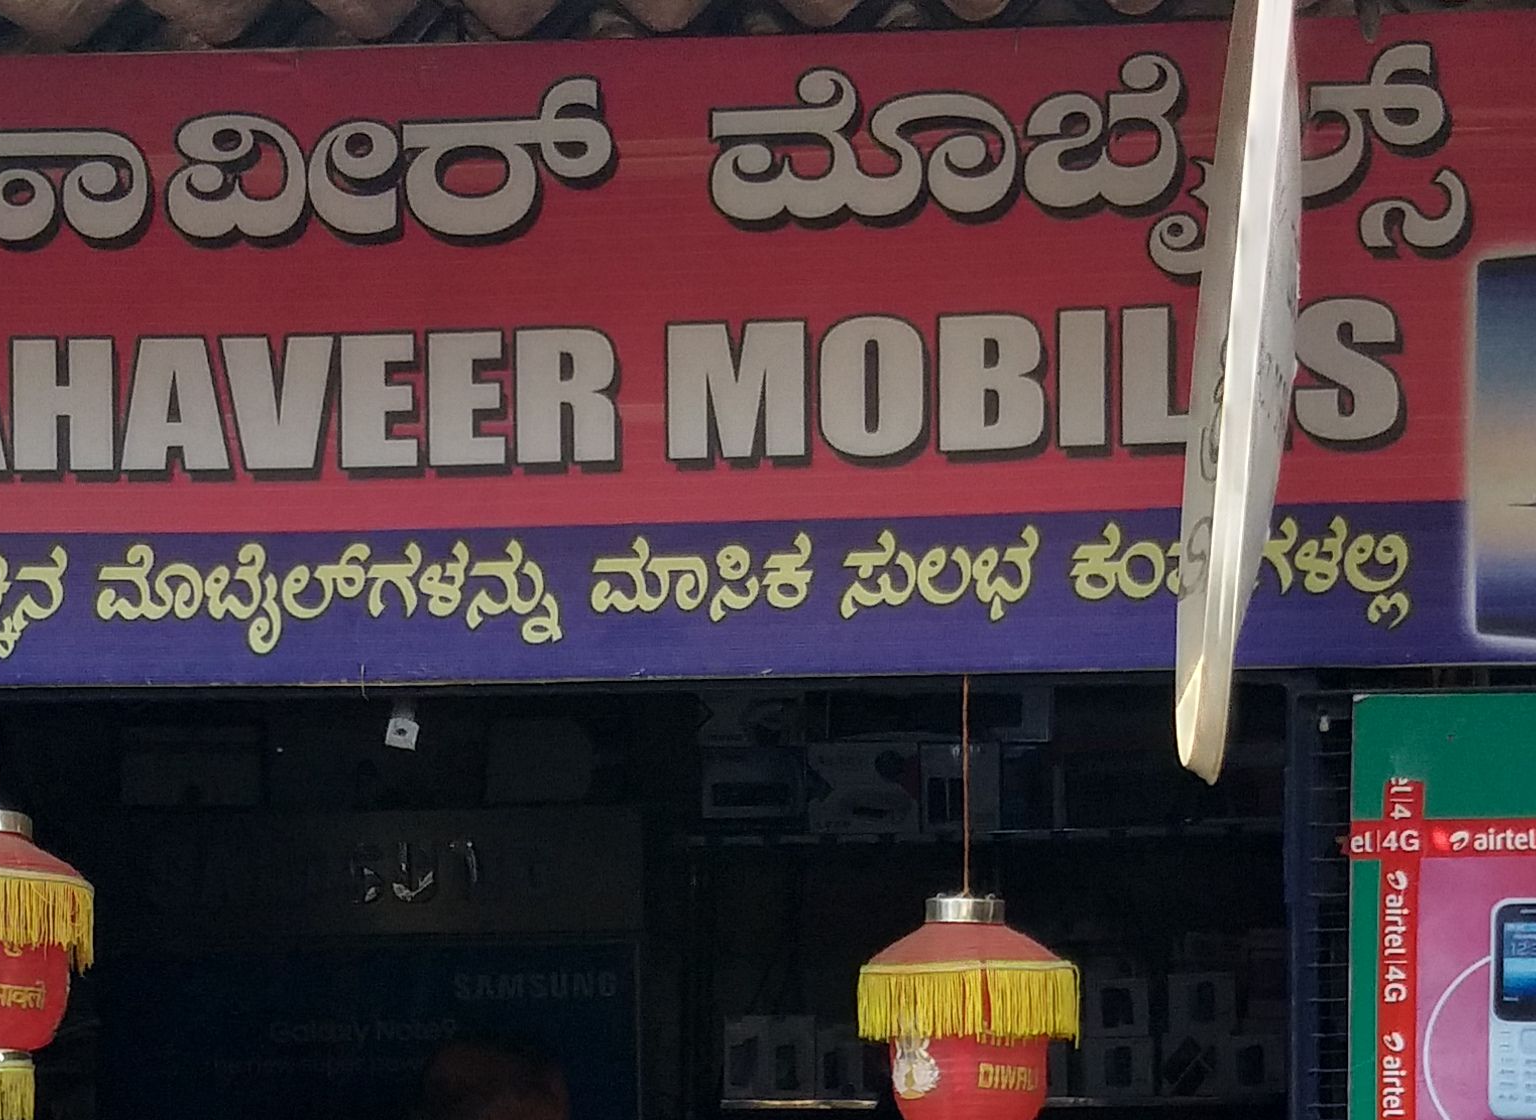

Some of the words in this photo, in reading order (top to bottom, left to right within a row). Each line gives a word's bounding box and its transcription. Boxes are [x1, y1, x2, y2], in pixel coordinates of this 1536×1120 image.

[666, 297, 1406, 470] MOBILS
[589, 531, 814, 623] ಮಾಸಿಕ
[837, 525, 1042, 624] ಸುಲಭ
[1473, 827, 1536, 850] airtel
[1384, 893, 1409, 956] airtel
[453, 971, 617, 999] SAMSUNG
[1384, 965, 1408, 1003] 4G
